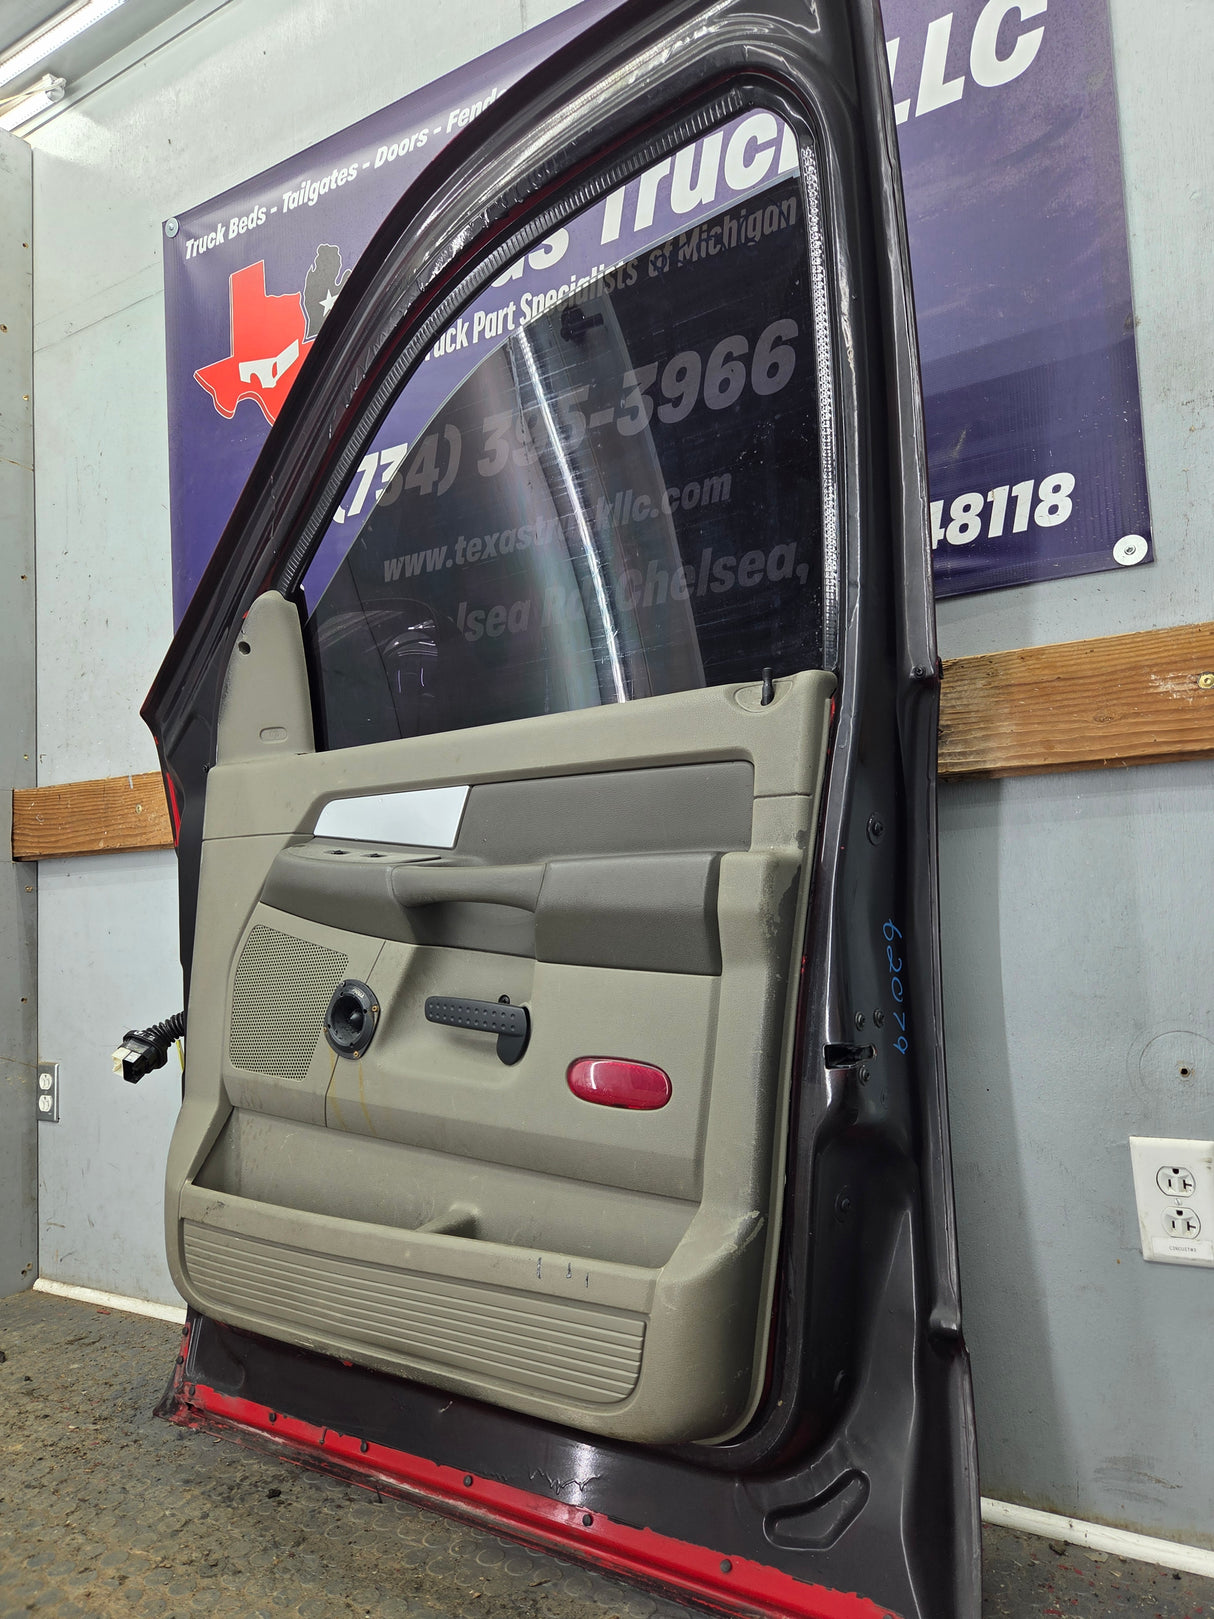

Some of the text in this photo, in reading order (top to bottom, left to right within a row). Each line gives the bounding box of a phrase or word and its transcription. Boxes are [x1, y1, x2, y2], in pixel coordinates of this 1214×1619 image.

[184, 223, 225, 260] Truck
[228, 205, 267, 240] Beds
[282, 162, 359, 214] Tailgates
[374, 128, 430, 169] Doors
[424, 318, 470, 361] uck
[472, 301, 516, 344] Part
[519, 260, 639, 326] Specialists
[648, 239, 673, 277] of
[678, 196, 797, 267] Michigan
[477, 317, 800, 477] 395-3966
[615, 541, 809, 613] Chelsea,
[882, 918, 909, 1055] 62079
